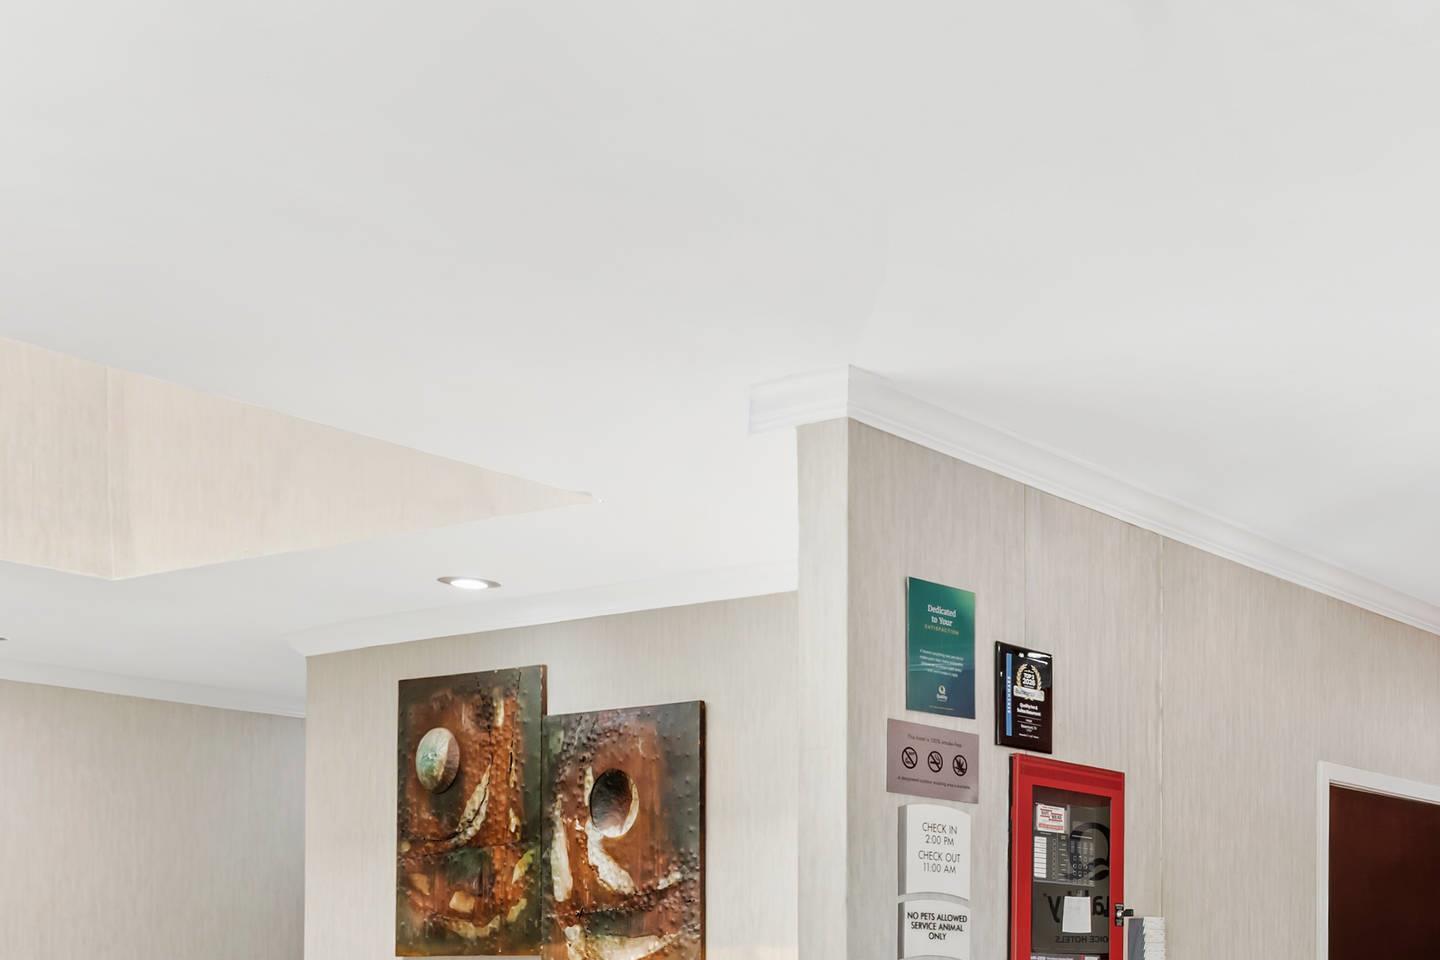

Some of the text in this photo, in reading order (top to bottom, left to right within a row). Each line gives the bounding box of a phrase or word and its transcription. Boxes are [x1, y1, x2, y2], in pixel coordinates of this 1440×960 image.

[928, 604, 957, 618] Dedicated
[931, 616, 953, 627] to Your
[922, 822, 957, 834] CHECK IN
[925, 834, 954, 846] 2:00 PM
[918, 850, 960, 863] CHECK OUT
[923, 862, 956, 874] 11:00 AM
[907, 911, 968, 923] NO PETS ALLOWED
[911, 921, 964, 932] SERVICE ANIMAL
[928, 931, 947, 941] ONLY
